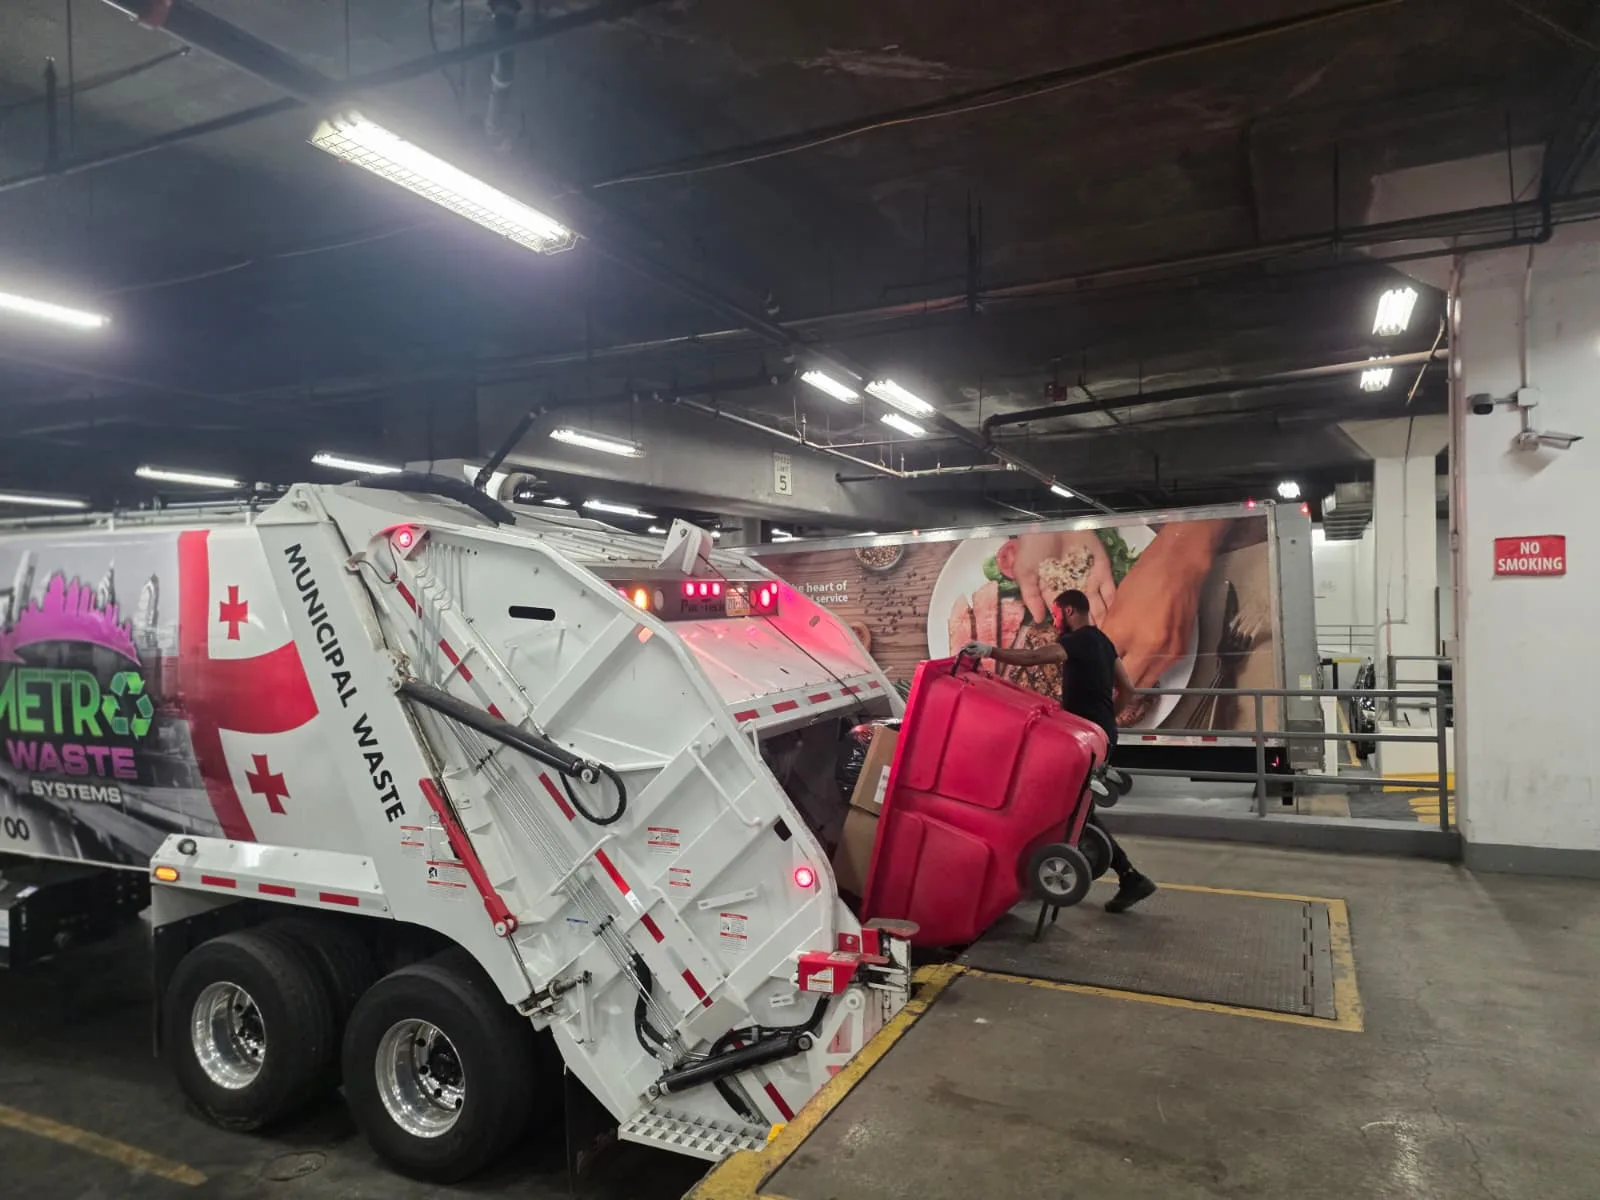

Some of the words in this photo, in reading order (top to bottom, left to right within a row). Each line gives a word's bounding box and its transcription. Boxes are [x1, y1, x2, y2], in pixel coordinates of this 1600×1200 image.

[779, 475, 787, 491] 5
[1520, 542, 1540, 555] NO
[1498, 557, 1563, 572] SMOKING
[806, 582, 834, 593] heart
[836, 580, 848, 591] of
[816, 594, 849, 603] service
[284, 543, 357, 708] MUNICIPAL
[352, 712, 406, 823] WASTE
[6, 738, 139, 780] WASTE
[31, 779, 124, 804] SYSTEMS
[0, 816, 30, 841] 00
